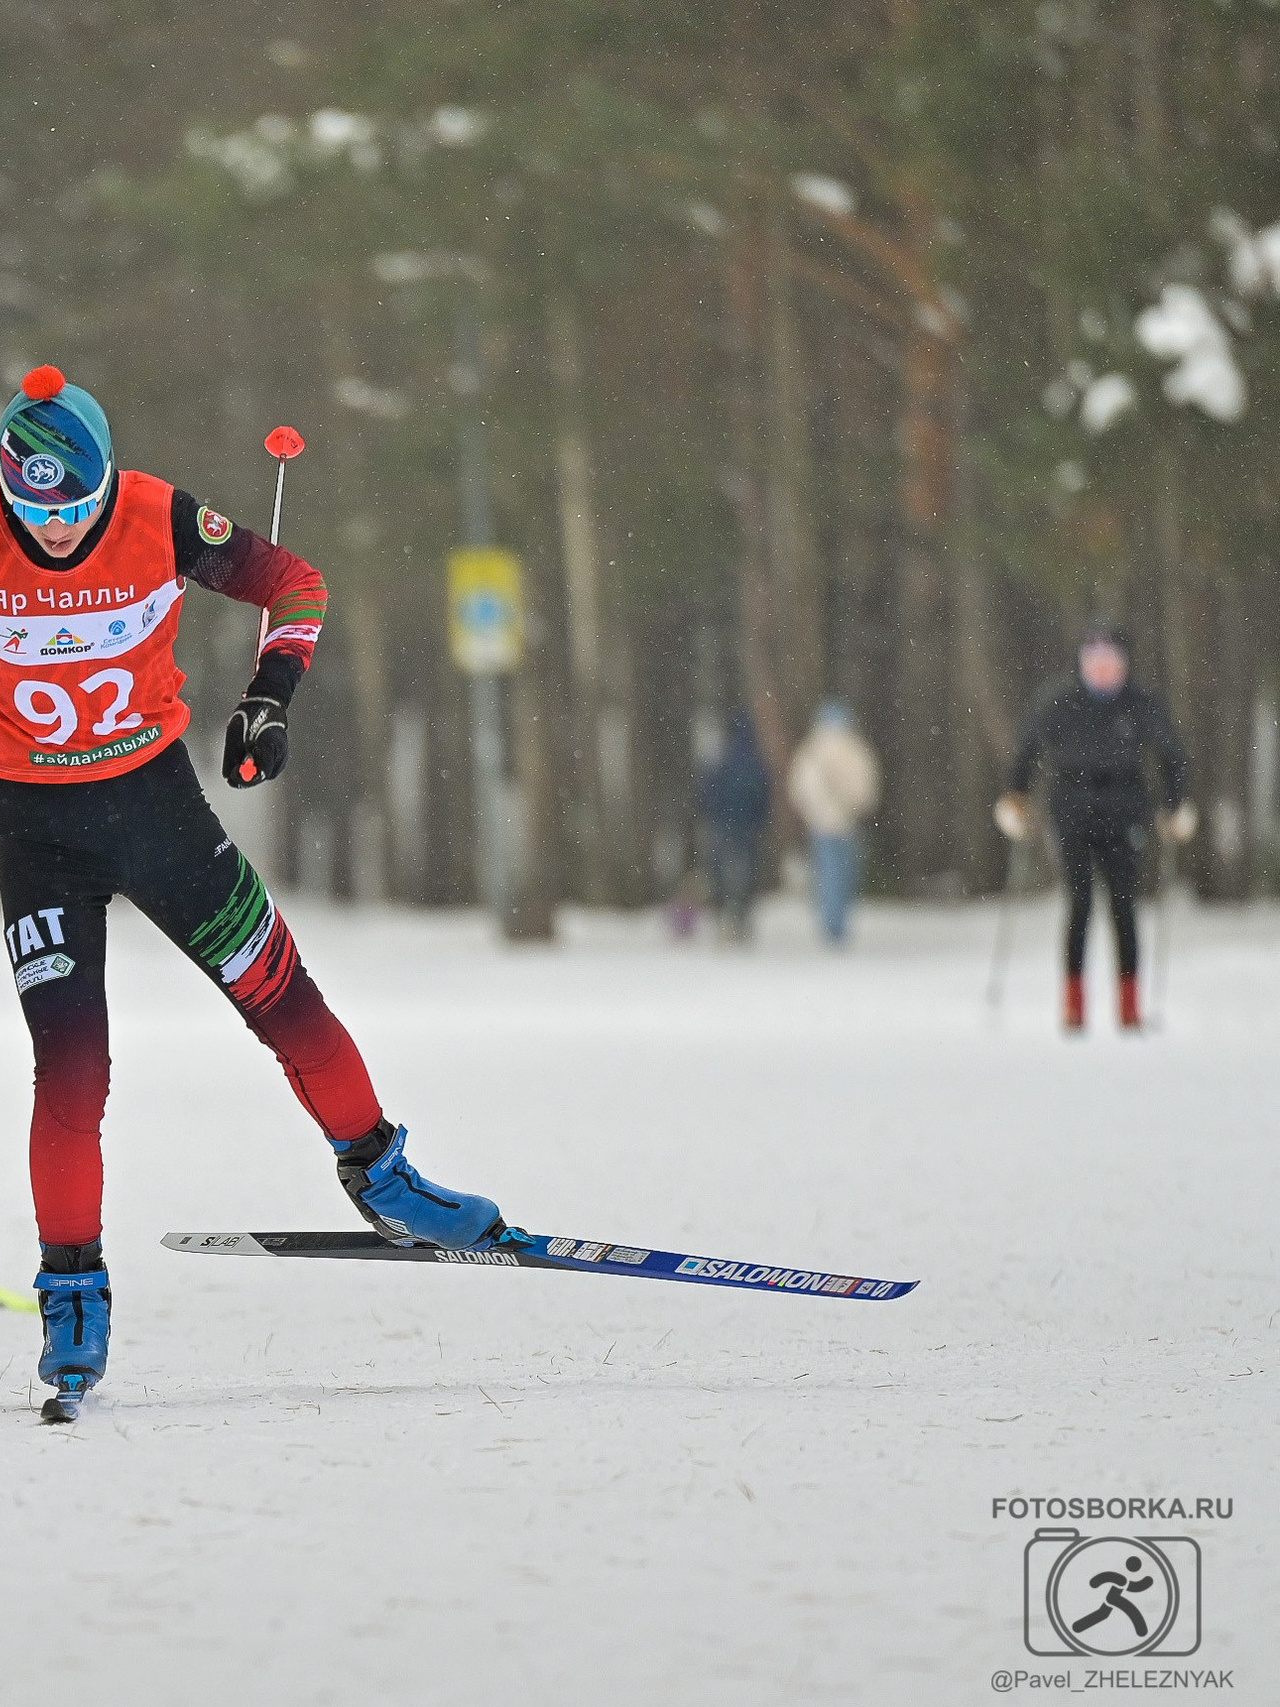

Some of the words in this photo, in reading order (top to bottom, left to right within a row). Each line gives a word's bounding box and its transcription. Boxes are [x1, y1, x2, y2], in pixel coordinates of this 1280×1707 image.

[36, 584, 135, 609] Чаллы
[13, 667, 144, 745] 92
[33, 726, 160, 766] #айданалыжи
[434, 1250, 520, 1266] SALOMON
[48, 1277, 94, 1288] SPINE
[702, 1261, 831, 1292] SALOMON
